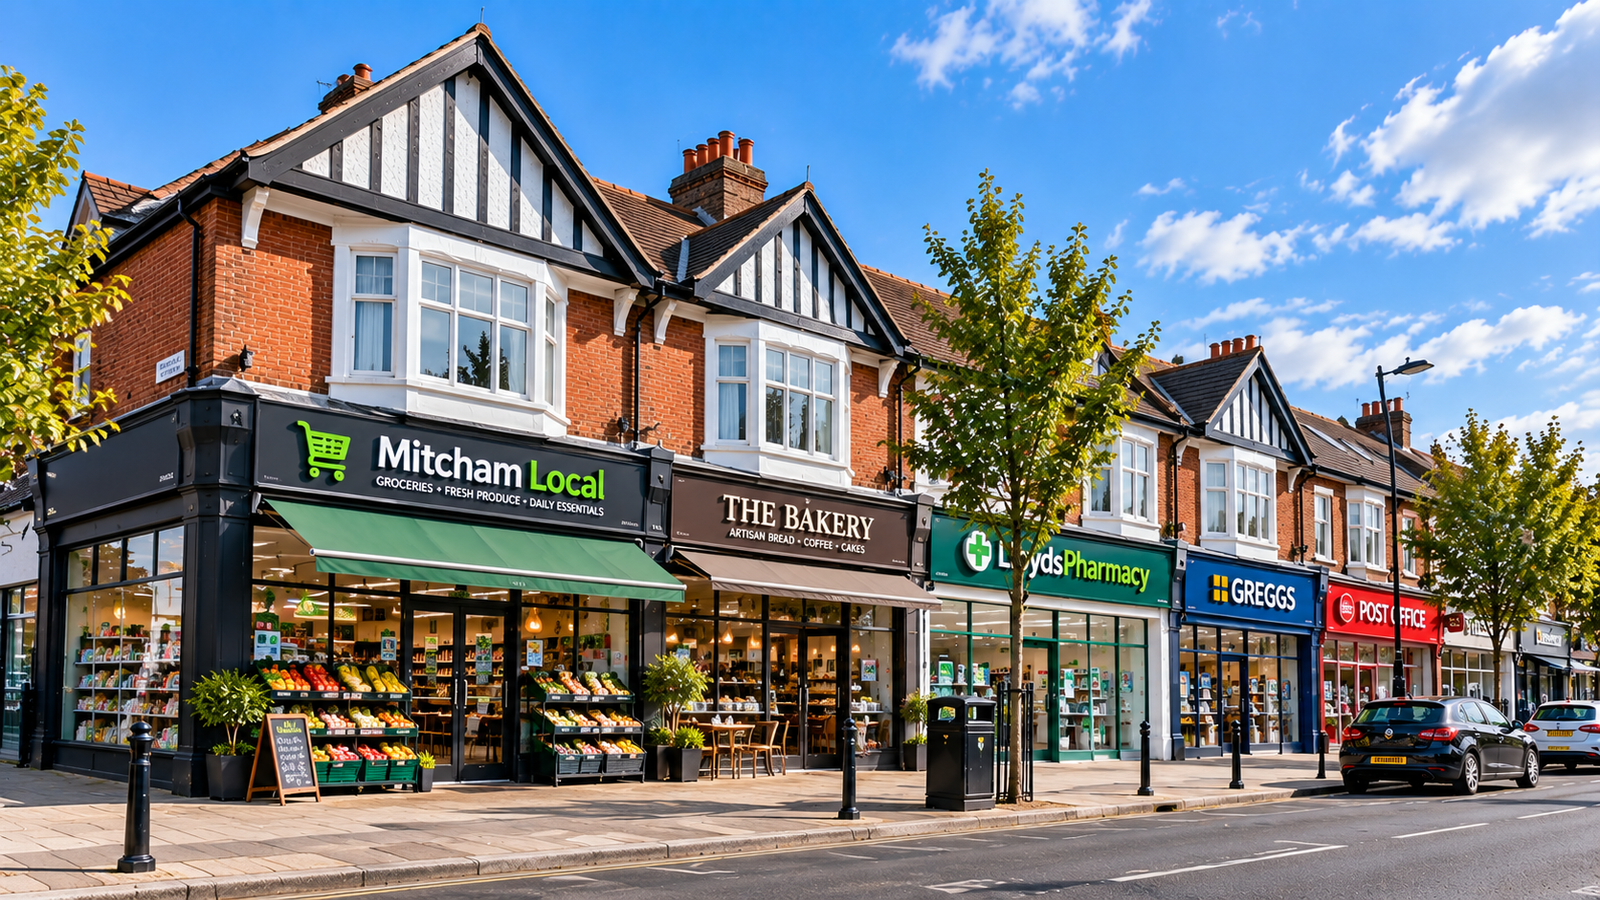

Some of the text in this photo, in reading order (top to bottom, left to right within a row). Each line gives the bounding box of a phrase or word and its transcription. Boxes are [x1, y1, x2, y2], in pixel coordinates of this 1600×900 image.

[378, 435, 605, 500] Mitcham Local
[376, 475, 605, 517] GROCERIES FRESH PRODUCE DAILY ESSENTIALS
[723, 493, 875, 541] THE BAKERY
[729, 527, 866, 554] ARTISAN BREAD COFFEE CAKES
[1231, 577, 1296, 611] GREGGS
[1359, 600, 1389, 624] POST
